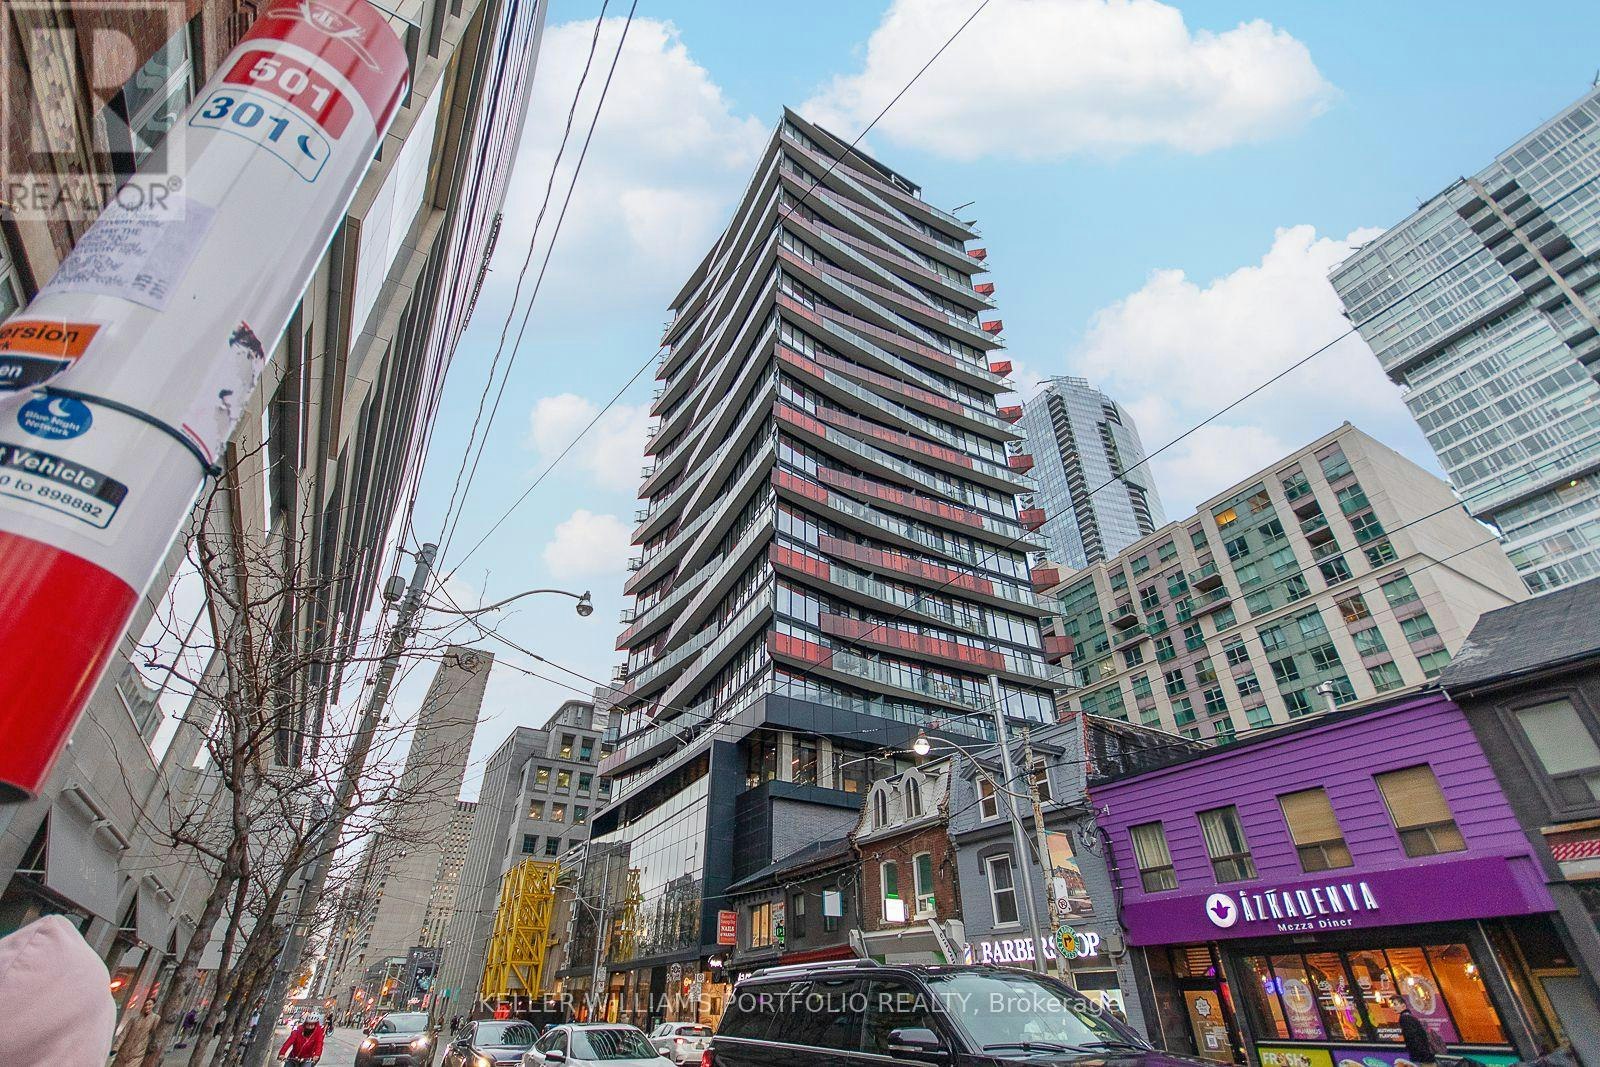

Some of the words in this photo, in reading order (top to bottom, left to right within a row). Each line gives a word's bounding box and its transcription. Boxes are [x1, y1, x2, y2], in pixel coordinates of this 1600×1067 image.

[248, 57, 330, 112] 501
[202, 96, 290, 143] 301
[25, 411, 49, 421] Blue
[51, 415, 80, 432] Night
[25, 418, 69, 437] Network
[13, 449, 96, 489] Vehicle
[15, 478, 33, 492] to
[37, 486, 103, 518] 898882
[1277, 921, 1313, 932] Mezza
[1319, 918, 1352, 929] Diner
[980, 932, 1101, 964] BARBERSOP
